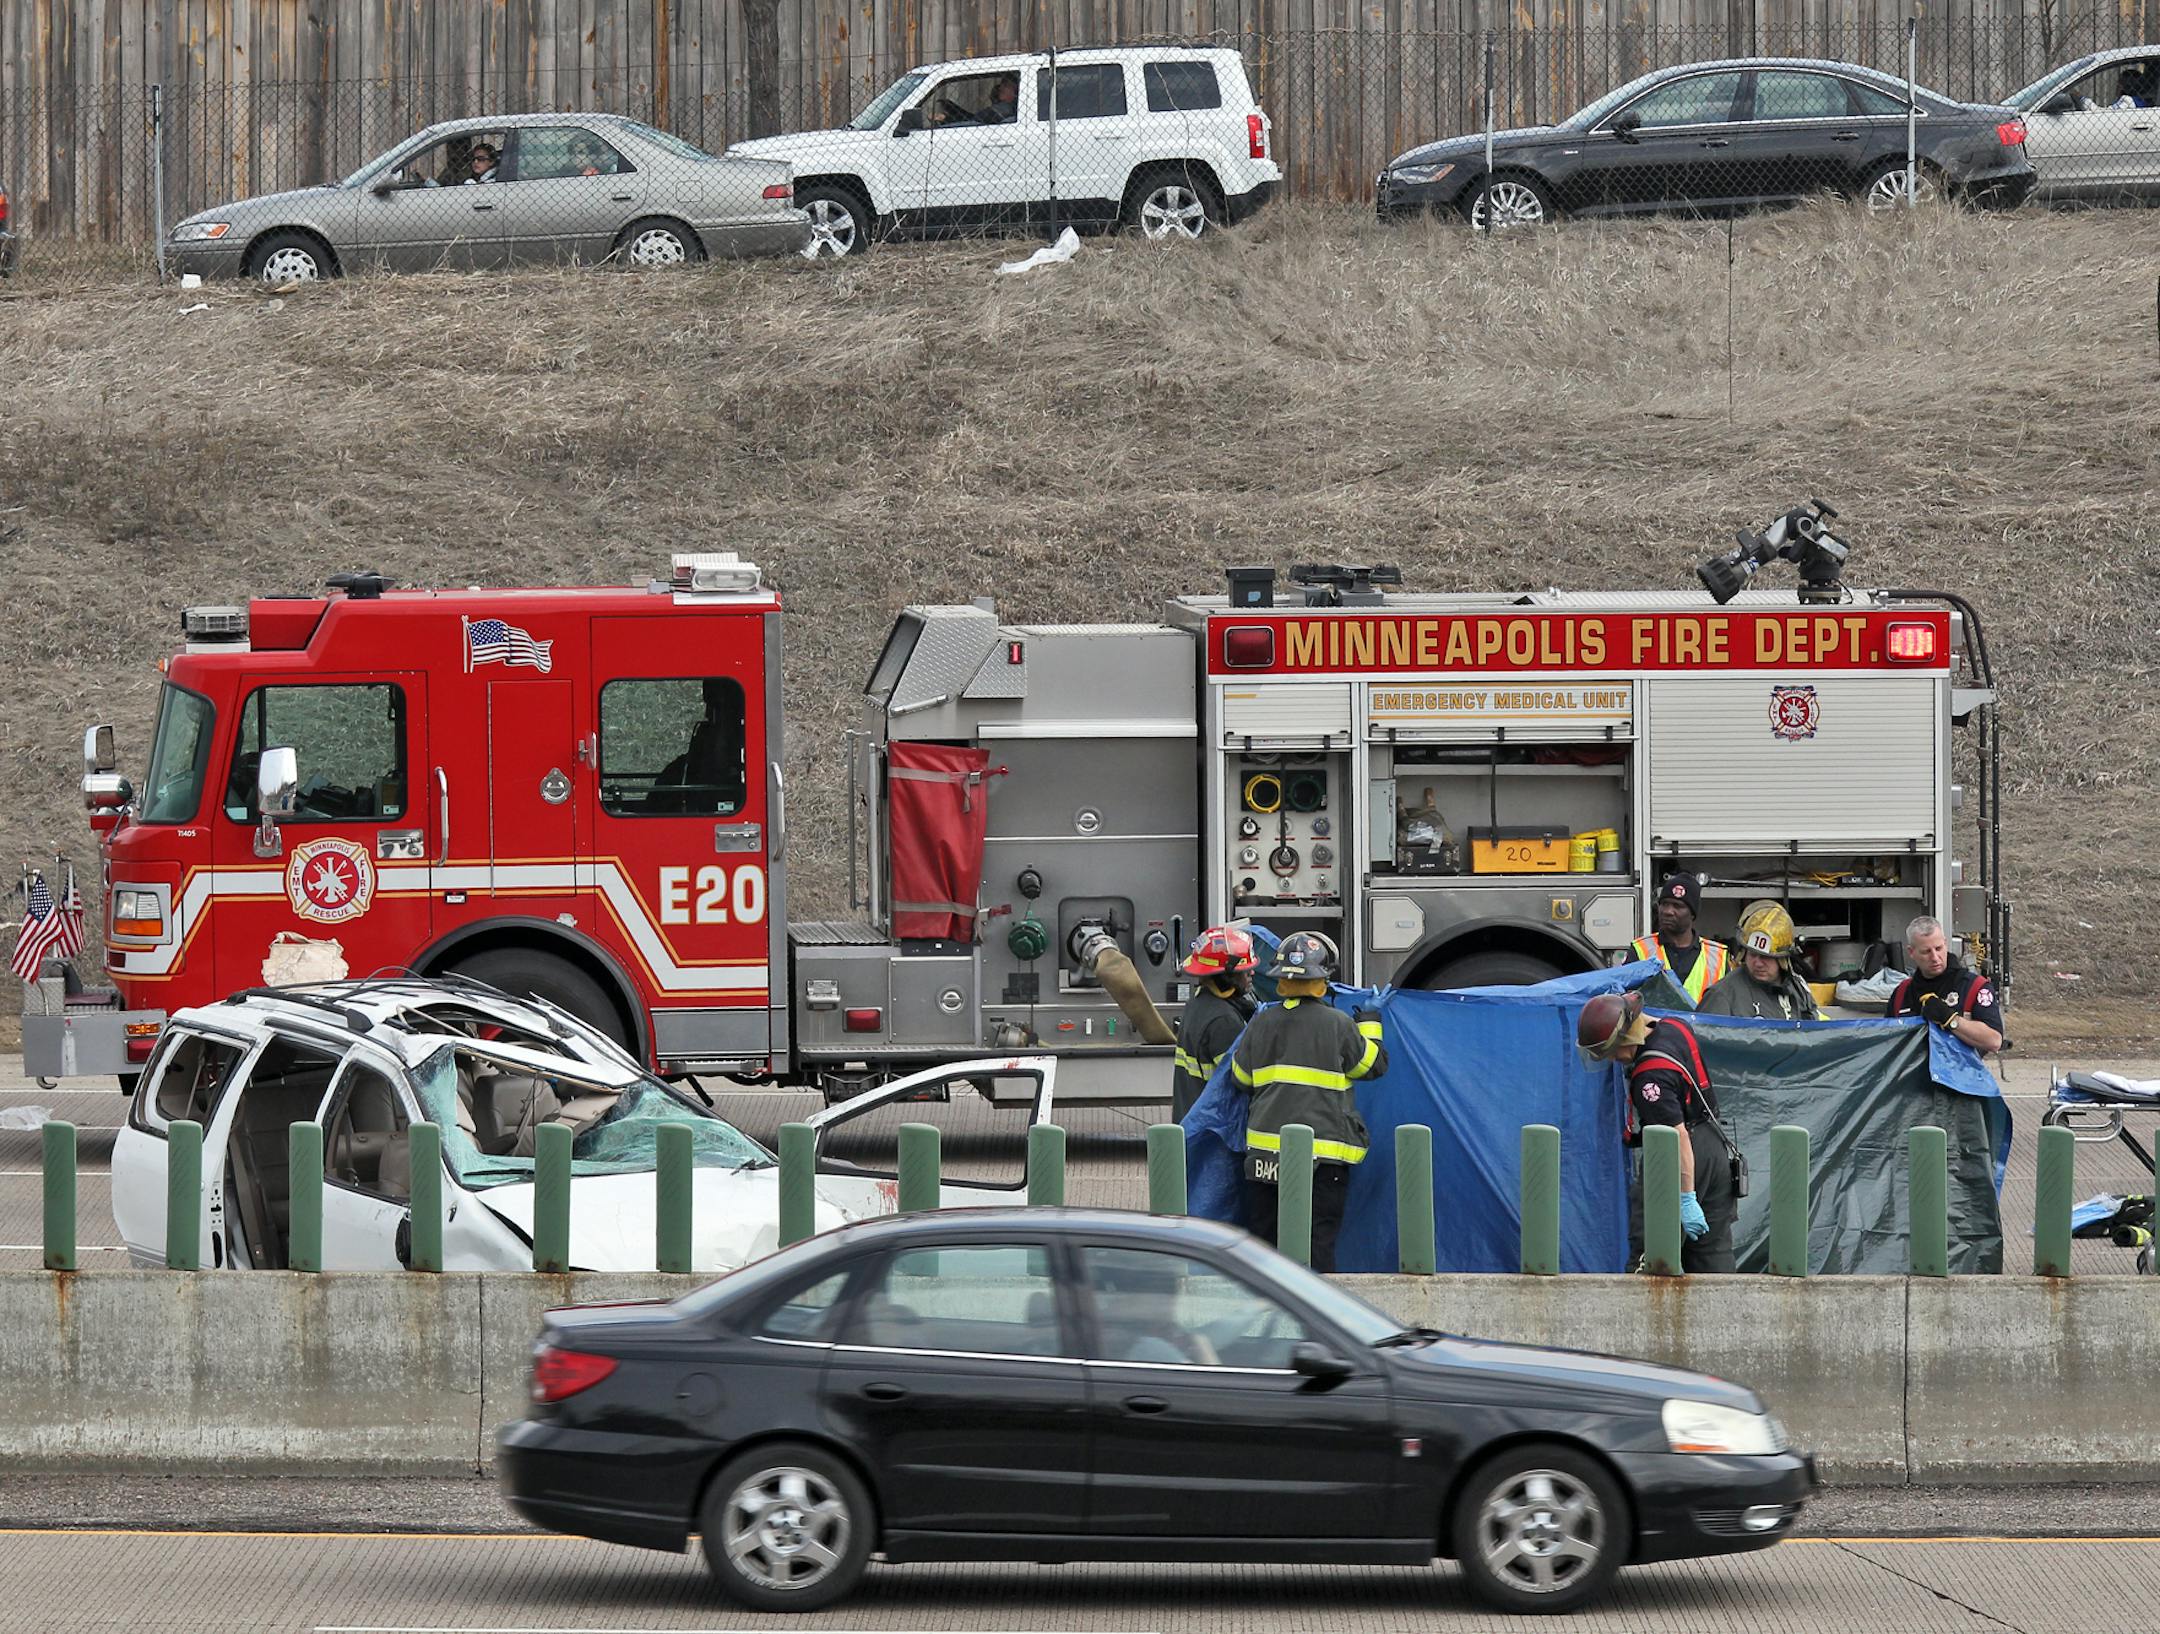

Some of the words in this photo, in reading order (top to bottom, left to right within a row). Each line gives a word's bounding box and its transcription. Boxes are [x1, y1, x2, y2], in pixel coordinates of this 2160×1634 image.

[1285, 618, 1607, 667] MINNEAPOLIS
[1631, 617, 1730, 664] FIRE
[1754, 616, 1879, 664] DEPT.
[1372, 692, 1488, 711] EMERGENCY
[1493, 691, 1577, 710] MEDICAL
[1583, 690, 1628, 709] UNIT
[310, 842, 351, 854] MINNEAPOLIS
[1506, 847, 1532, 862] 20
[292, 866, 301, 897] EMT
[659, 864, 766, 925] E20
[313, 908, 351, 918] RESCUE
[1754, 935, 1767, 950] 10
